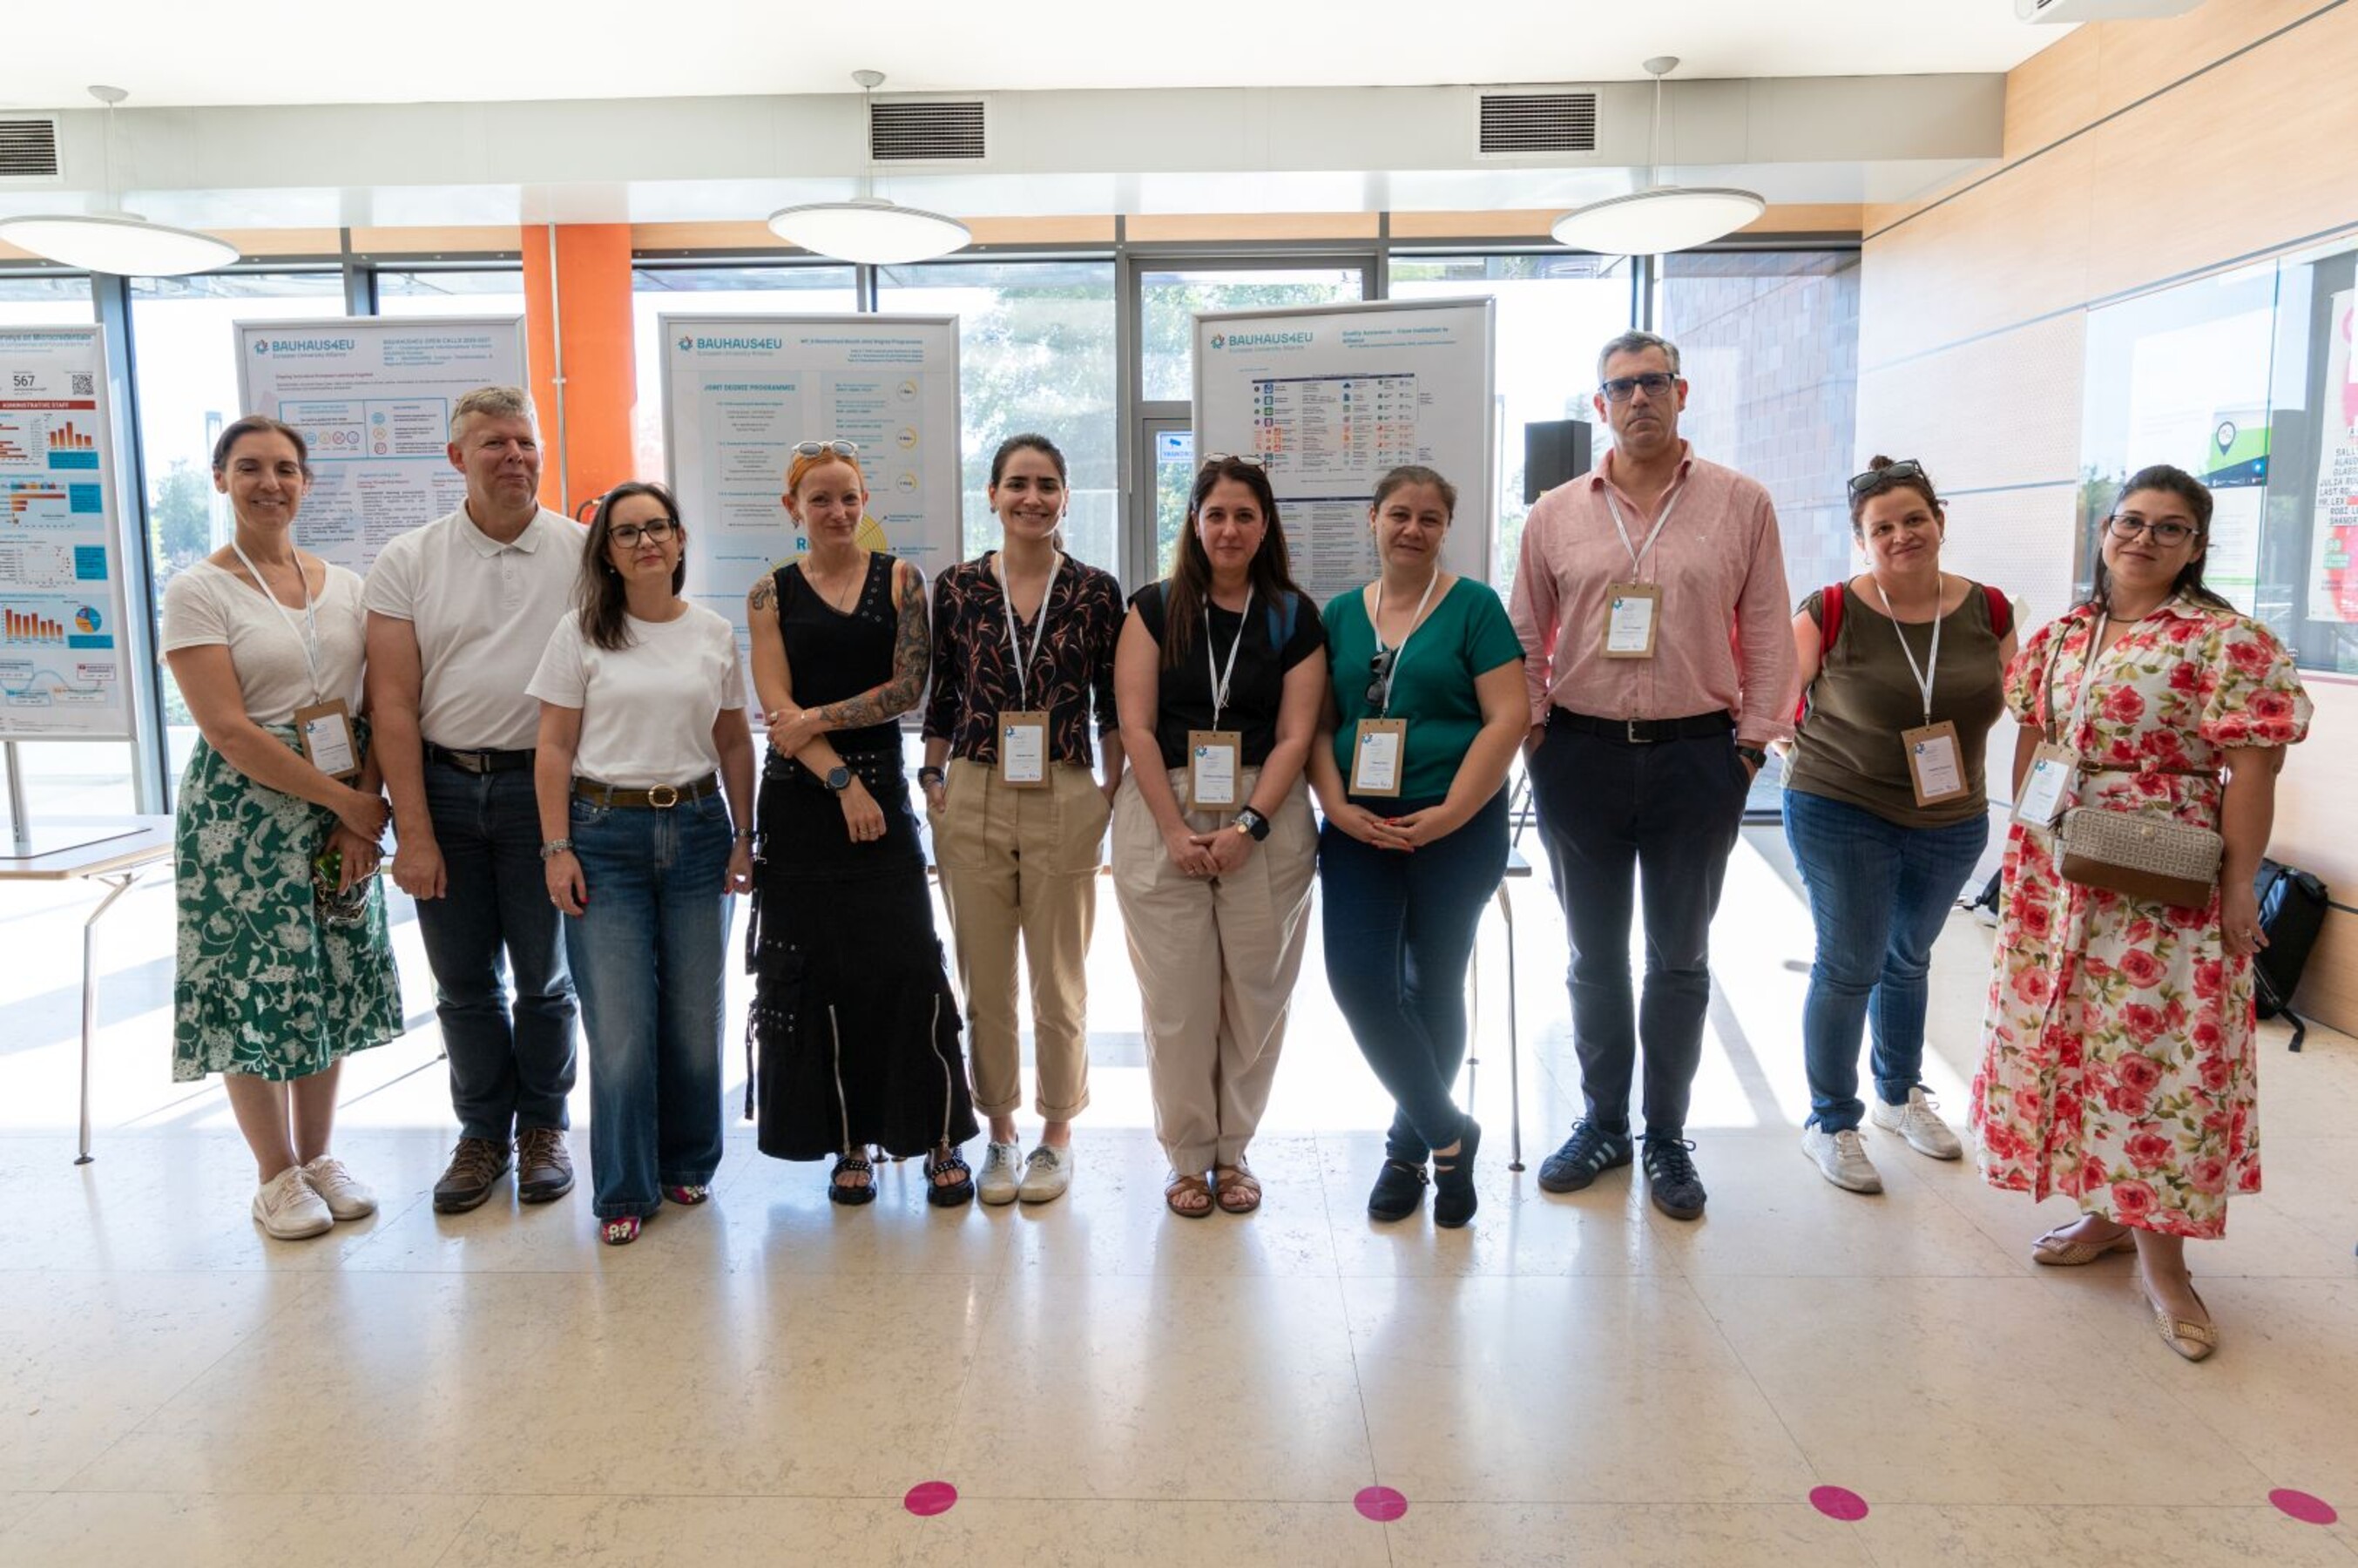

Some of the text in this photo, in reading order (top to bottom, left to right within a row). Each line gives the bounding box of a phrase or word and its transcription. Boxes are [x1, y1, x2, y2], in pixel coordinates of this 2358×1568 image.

[273, 339, 355, 351] BAUHAUS4EU
[697, 338, 782, 349] BAUHAUS4EU
[1229, 332, 1313, 346] BAUHAUS4EU
[13, 375, 35, 387] 567
